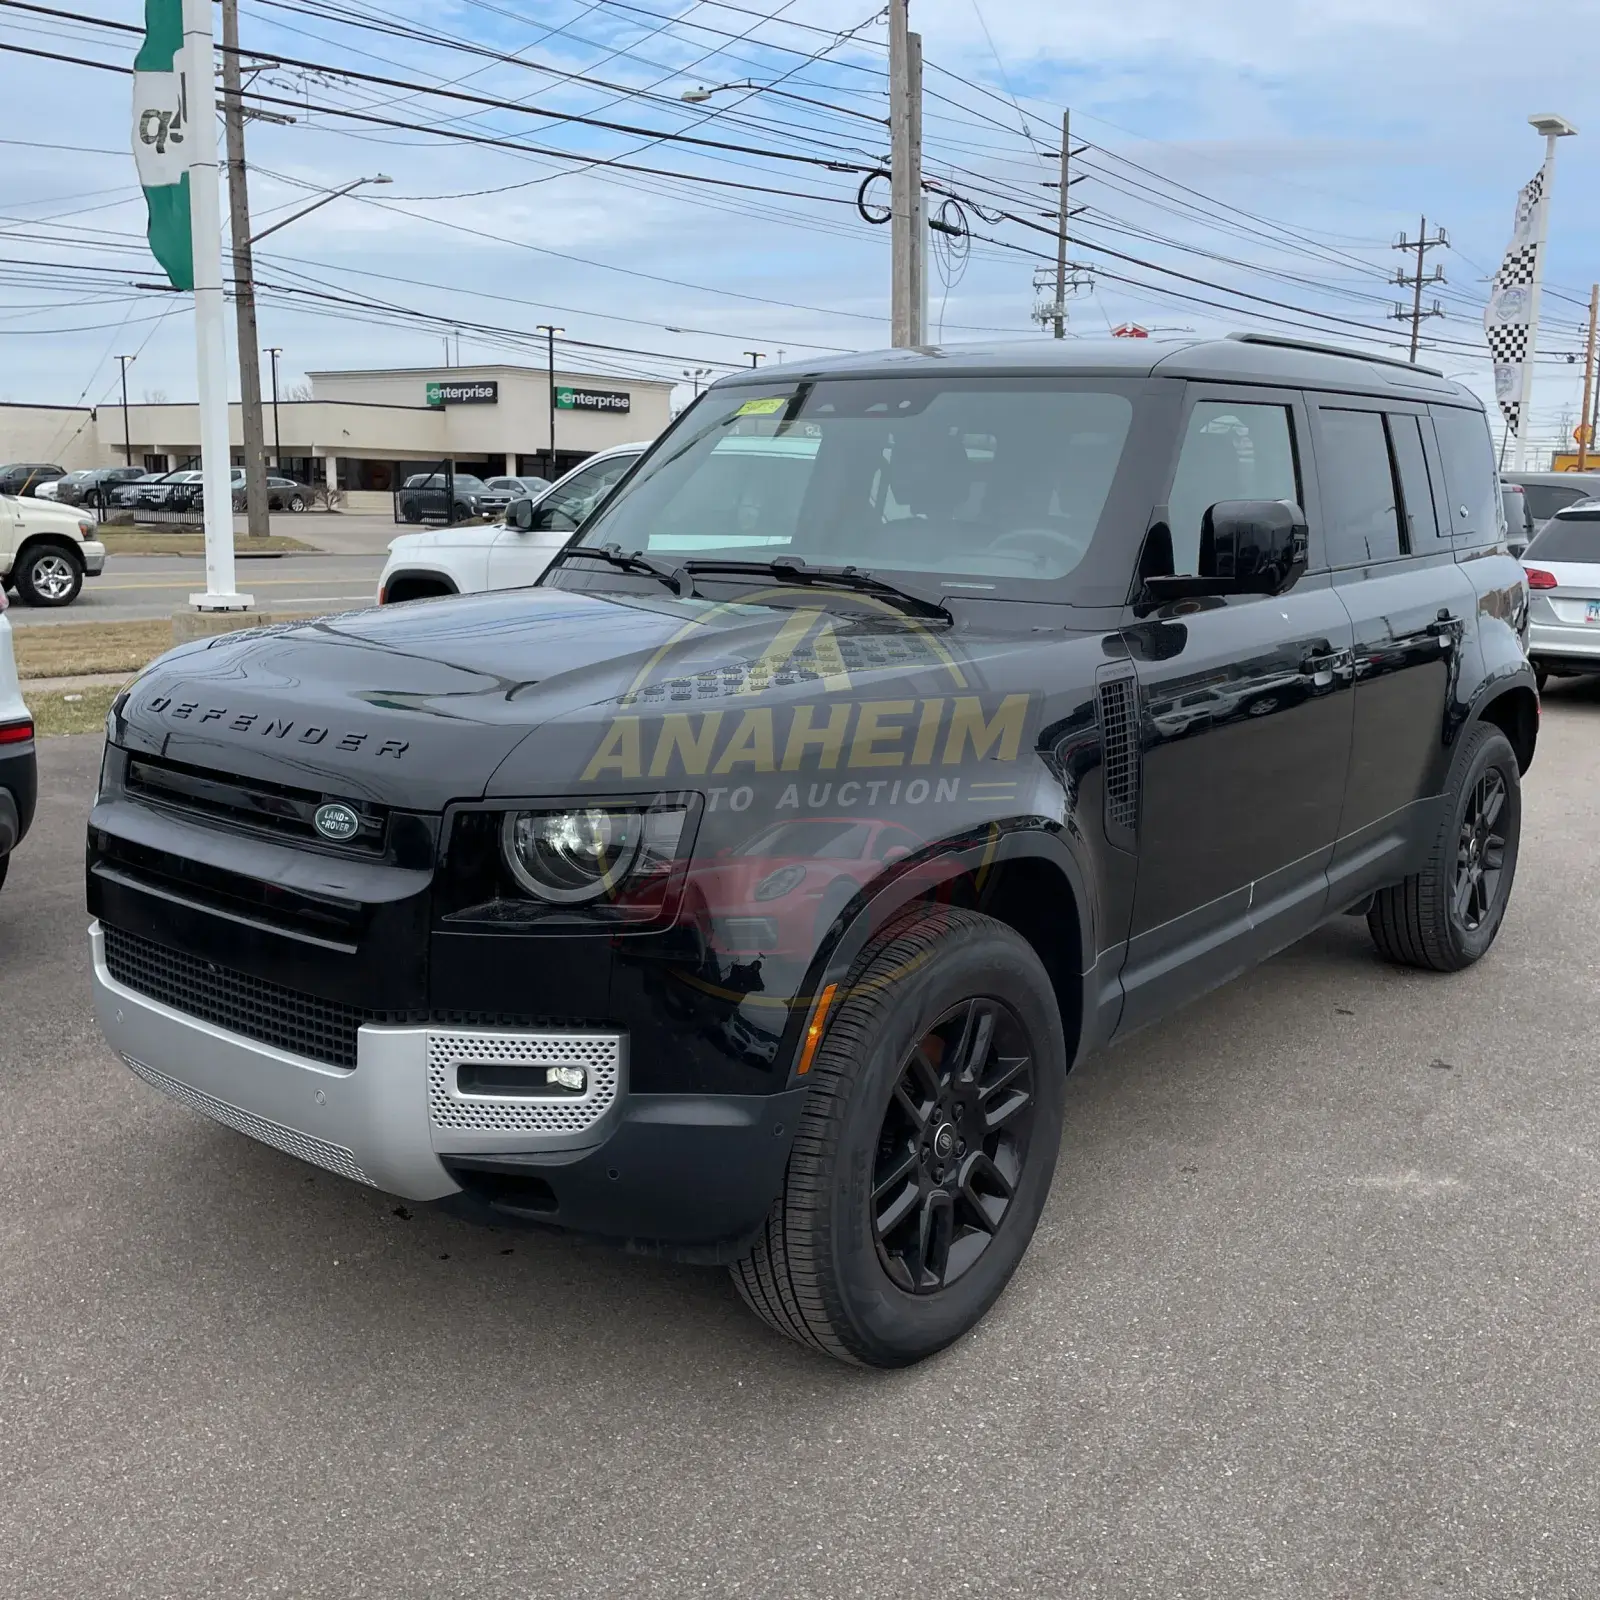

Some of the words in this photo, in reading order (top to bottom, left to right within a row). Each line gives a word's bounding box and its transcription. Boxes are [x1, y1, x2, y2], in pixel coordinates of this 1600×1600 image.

[427, 385, 493, 402] enterprise
[557, 392, 629, 408] enterprise
[147, 697, 409, 758] DEFENDER
